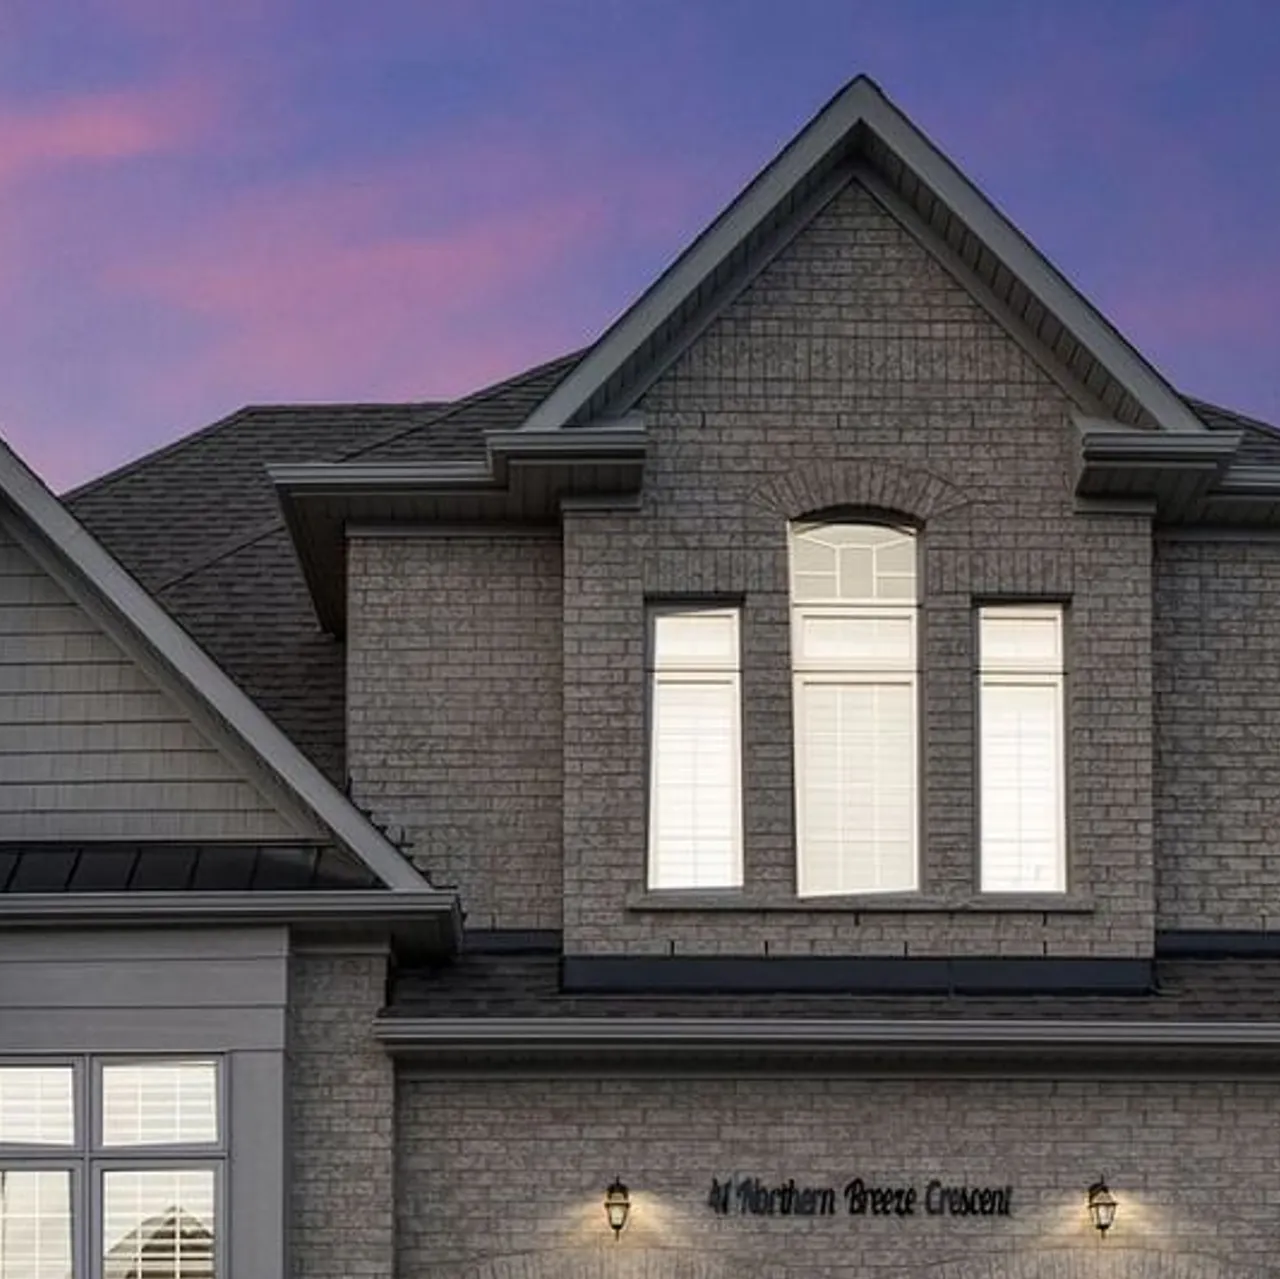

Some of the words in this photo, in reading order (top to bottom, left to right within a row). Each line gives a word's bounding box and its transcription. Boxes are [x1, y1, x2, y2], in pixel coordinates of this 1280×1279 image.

[736, 1177, 836, 1216] Northern
[844, 1176, 917, 1217] Breeze
[924, 1178, 1014, 1217] Crescent
